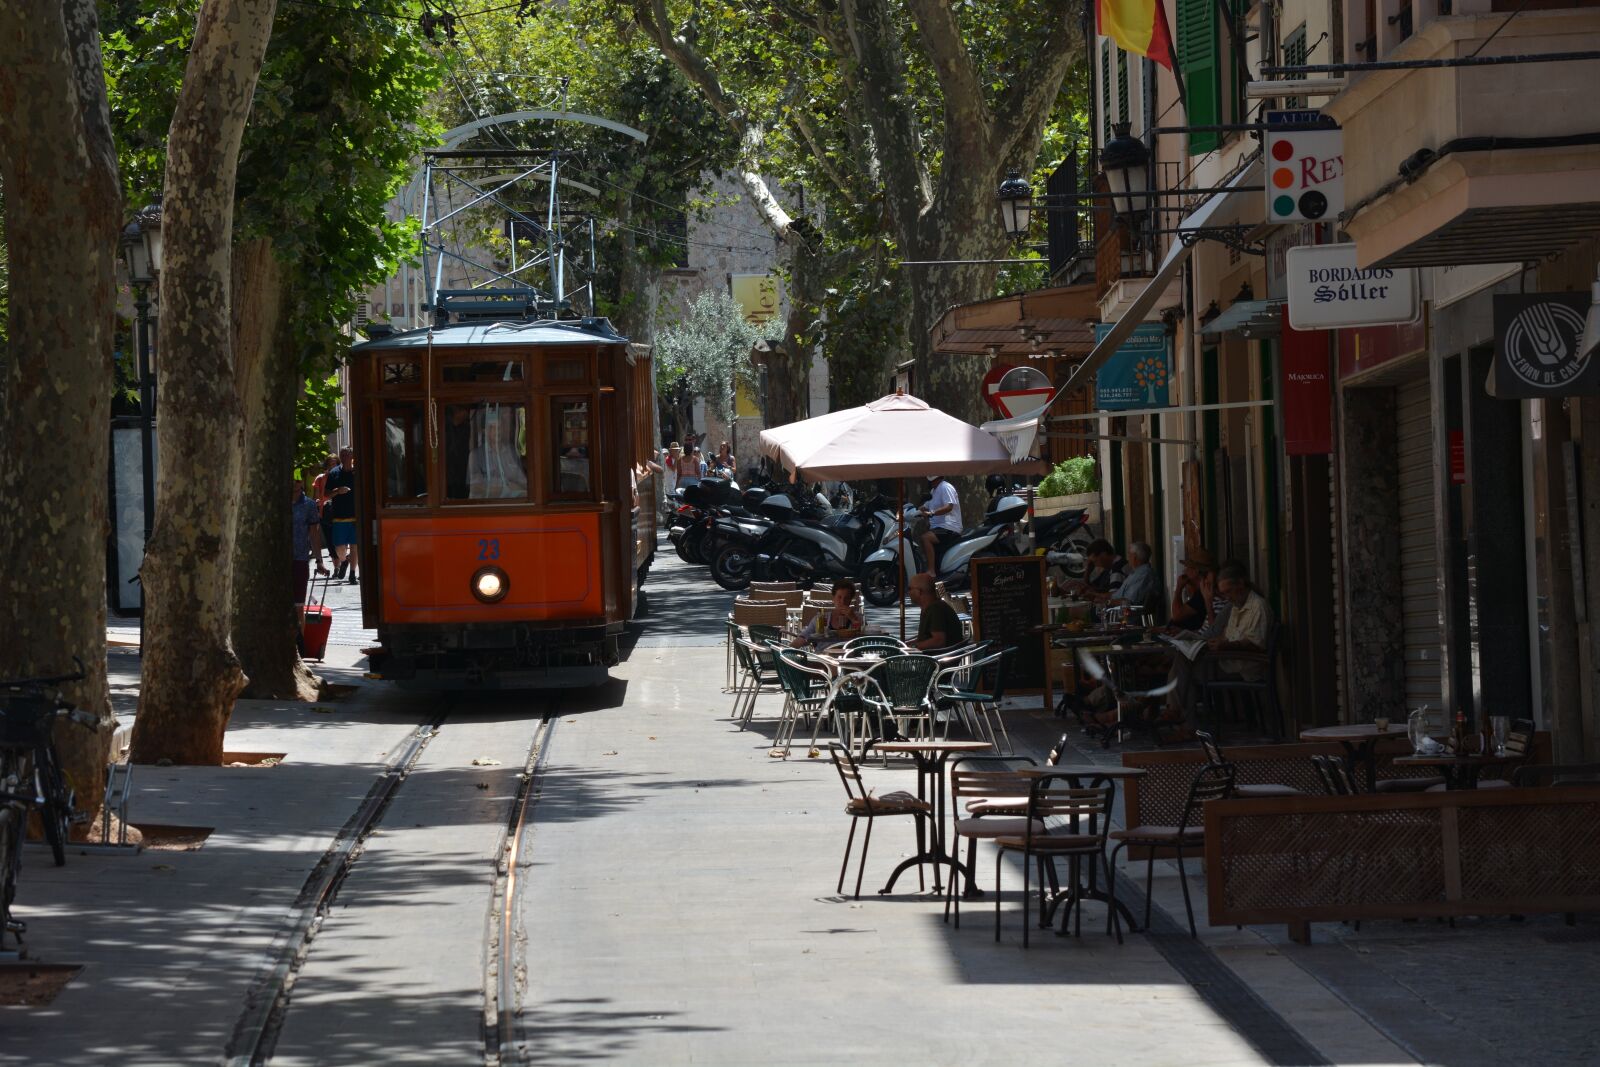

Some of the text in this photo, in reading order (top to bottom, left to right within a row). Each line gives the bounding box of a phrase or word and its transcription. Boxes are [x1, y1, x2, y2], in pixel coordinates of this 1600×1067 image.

[1309, 266, 1394, 283] BORDADOS
[1313, 283, 1389, 303] Sóller
[1516, 358, 1541, 381] FORN
[1544, 371, 1557, 384] DE
[479, 539, 499, 560] 23
